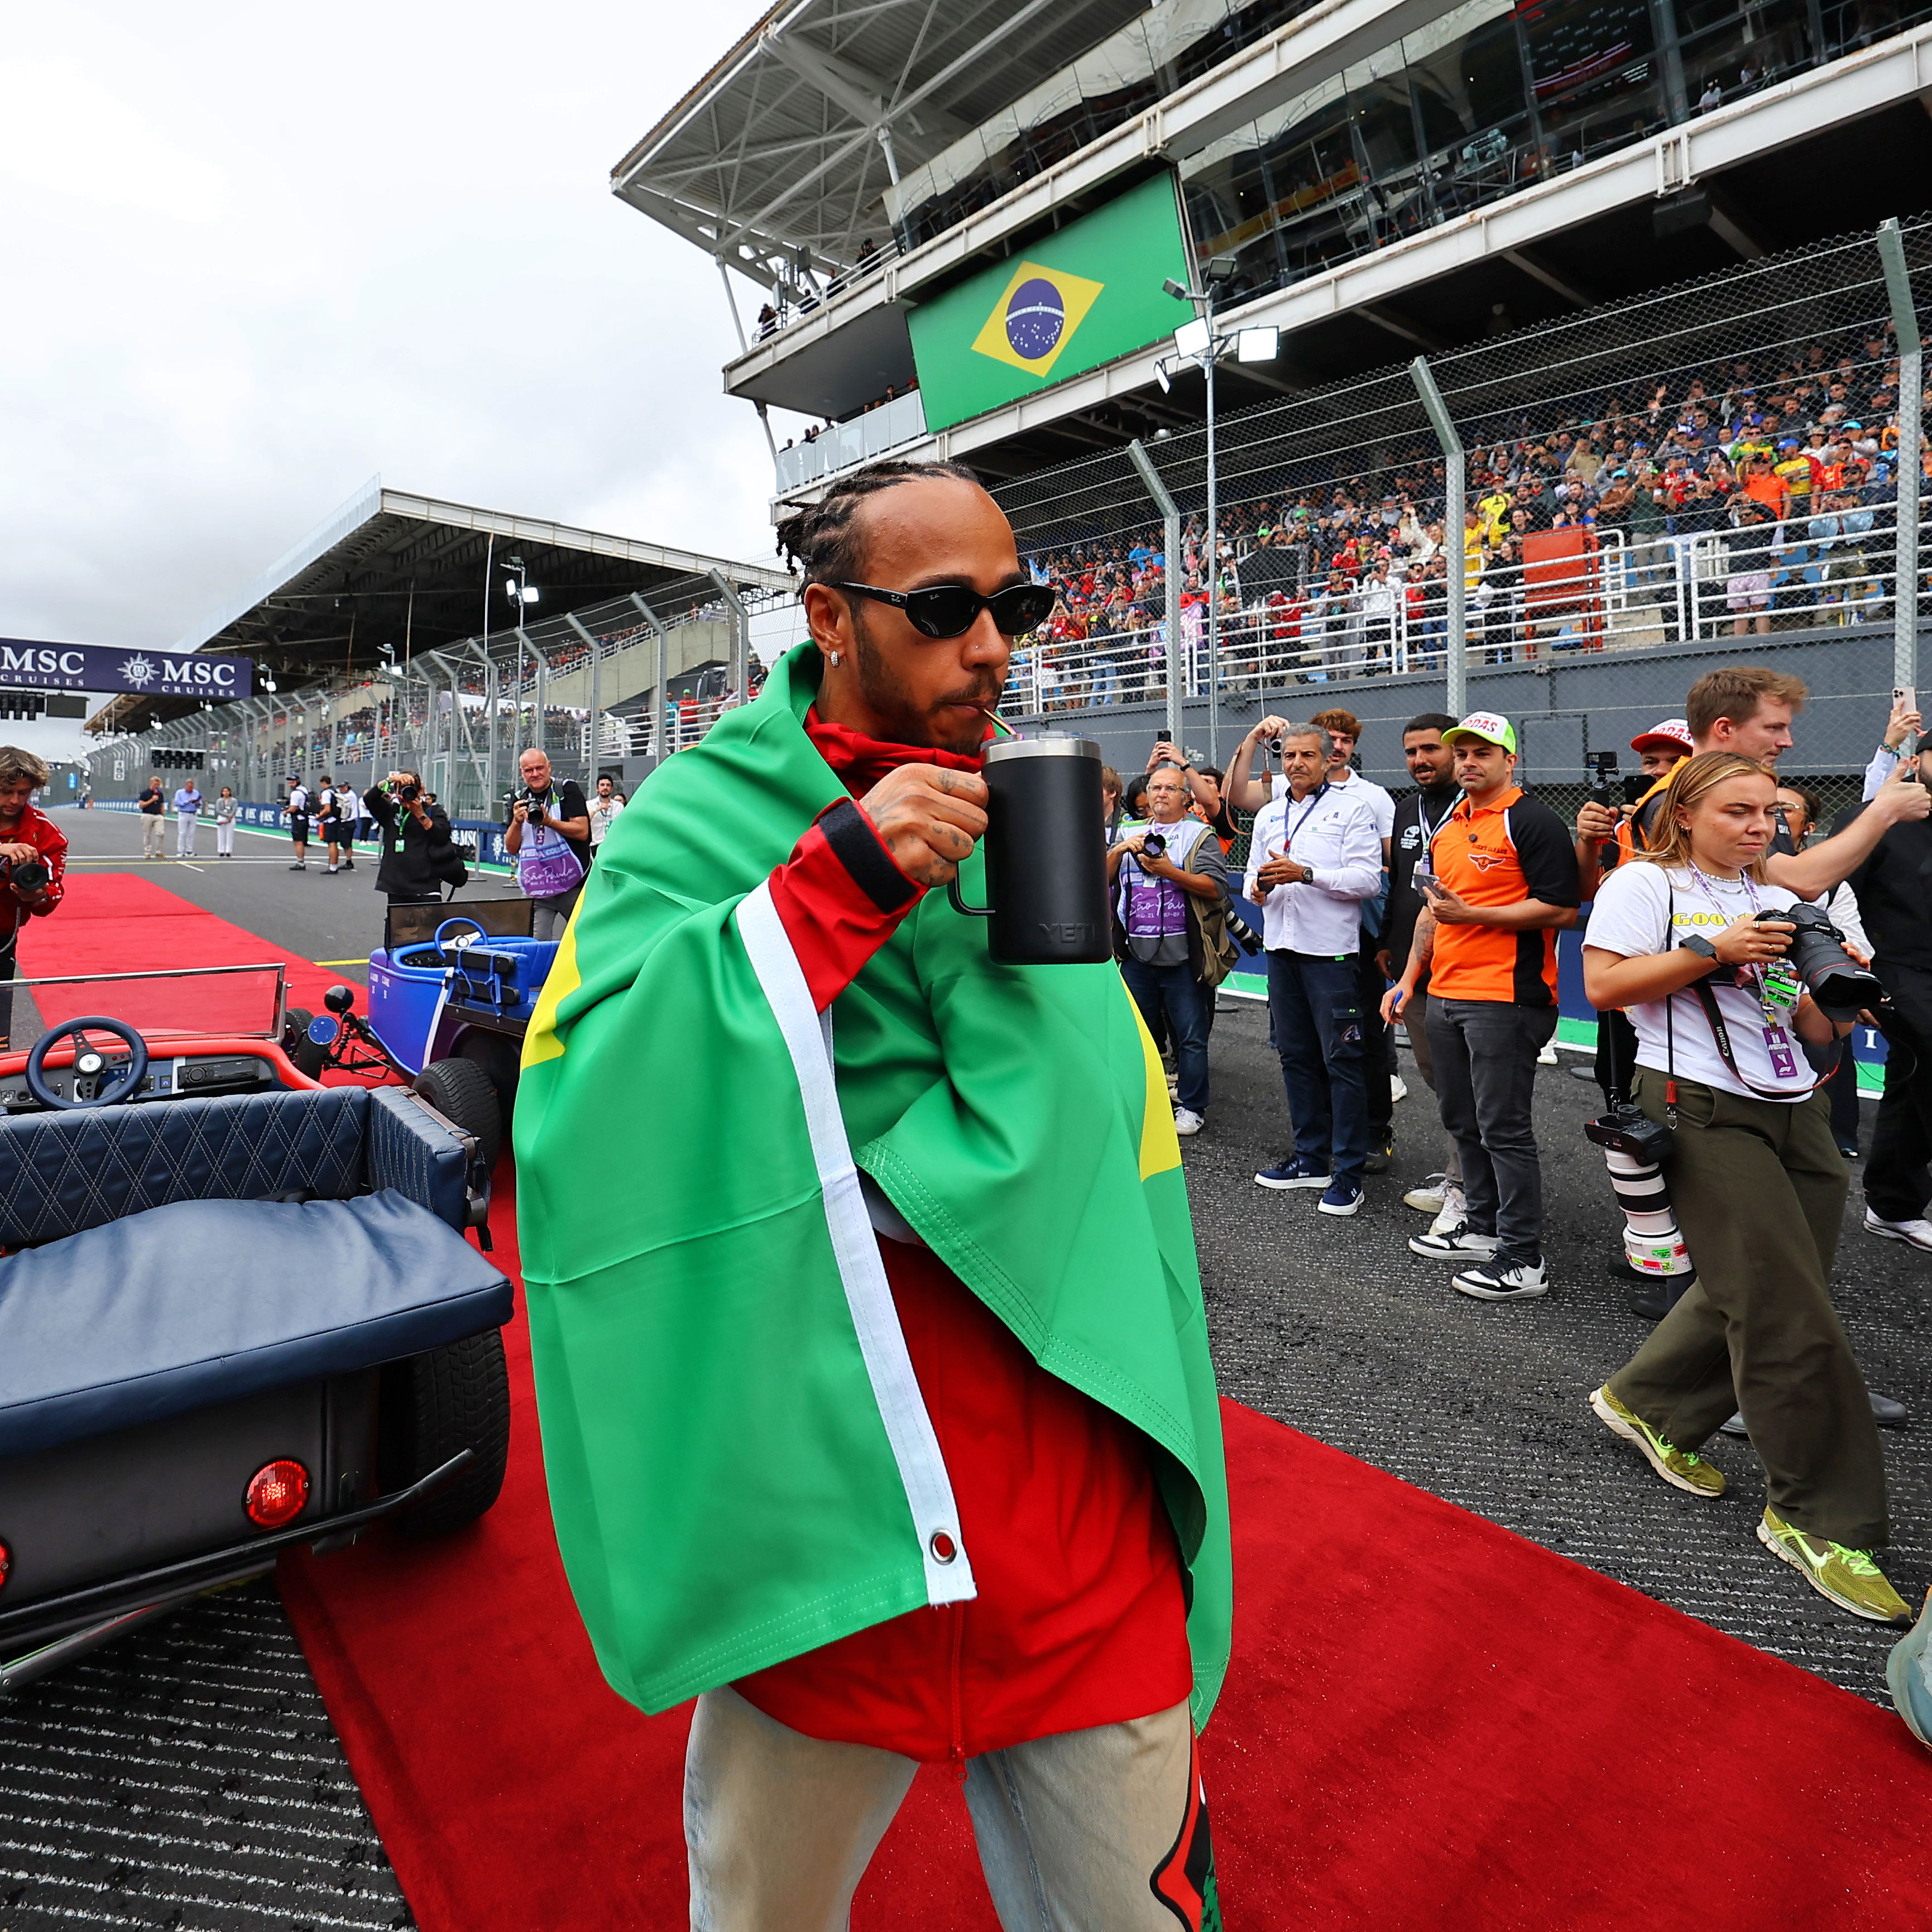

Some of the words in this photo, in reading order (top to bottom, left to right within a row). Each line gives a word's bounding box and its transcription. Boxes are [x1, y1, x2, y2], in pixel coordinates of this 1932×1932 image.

[1, 646, 84, 675] MSC
[1, 674, 84, 686] CRUISES
[161, 659, 235, 686] MSC
[161, 685, 235, 697] CRUISES
[1038, 923, 1095, 943] YETI
[1716, 1026, 1729, 1057] Canon
